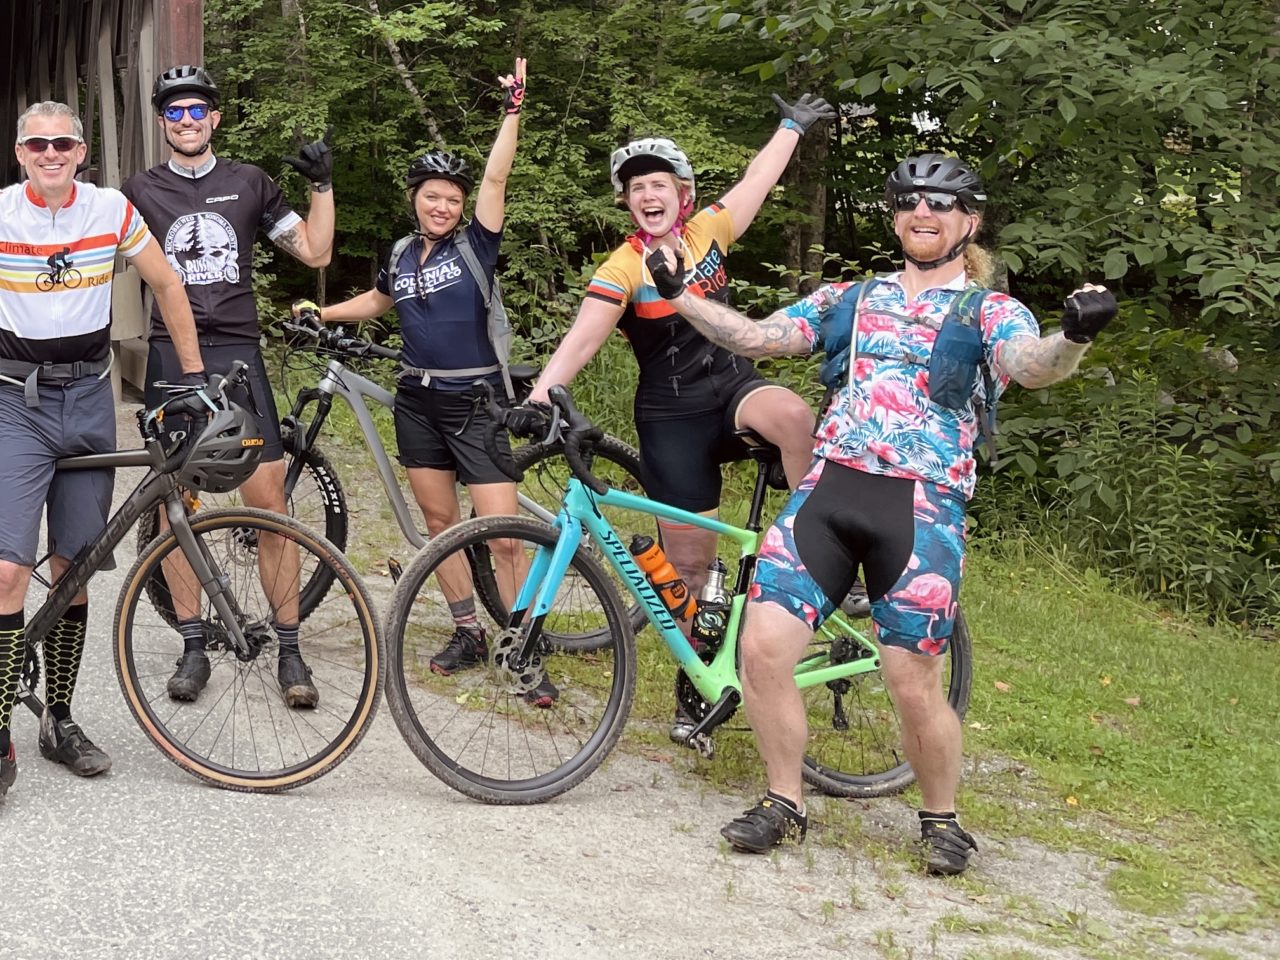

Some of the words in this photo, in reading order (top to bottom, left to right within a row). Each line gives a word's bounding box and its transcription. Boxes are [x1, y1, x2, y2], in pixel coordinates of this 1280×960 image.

[87, 274, 110, 288] Ride
[187, 271, 223, 281] RIVER
[446, 268, 462, 280] CO
[317, 466, 341, 514] MAXXIS
[599, 531, 677, 630] SPECIALIZED
